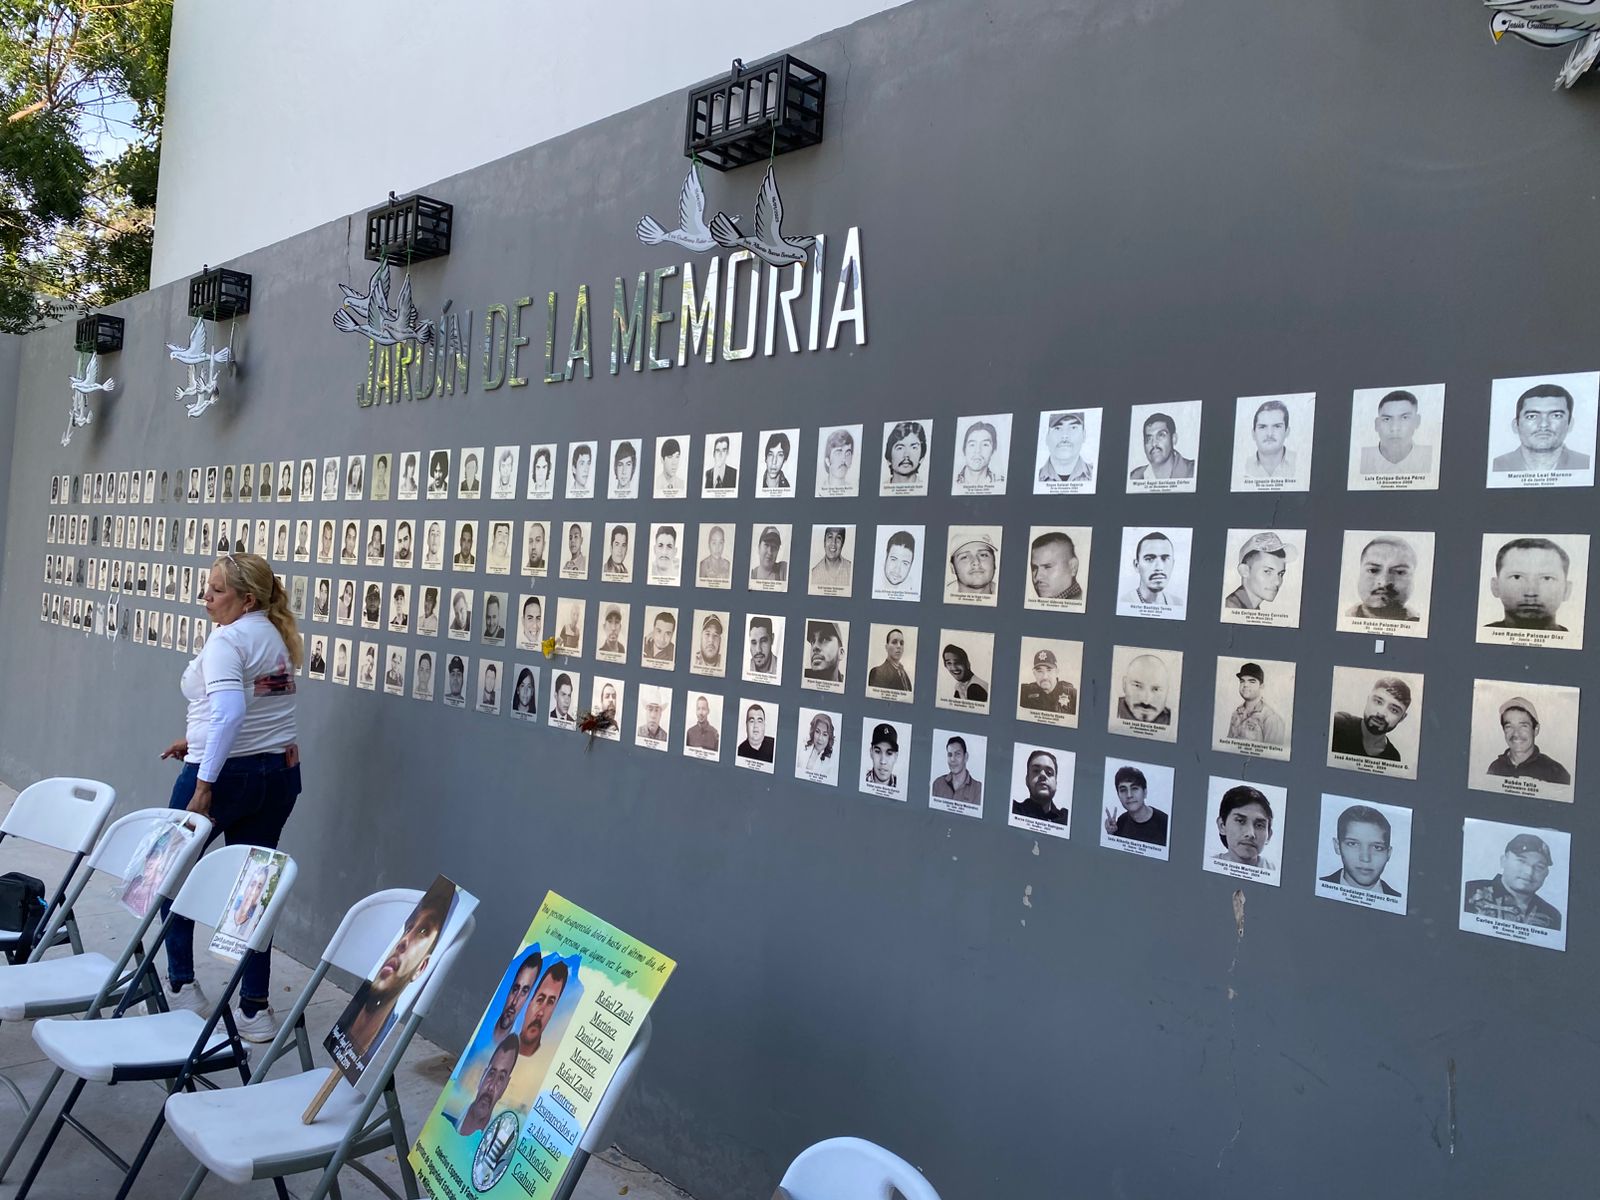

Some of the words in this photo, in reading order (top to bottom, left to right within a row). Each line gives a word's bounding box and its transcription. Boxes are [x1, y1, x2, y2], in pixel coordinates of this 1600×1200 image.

[356, 299, 473, 409] JARDÍN
[482, 296, 532, 391] DE
[544, 284, 592, 384] LA
[610, 226, 866, 376] MEMORIA
[605, 959, 616, 968] vez
[606, 936, 620, 950] hasta
[621, 944, 630, 954] el
[657, 962, 666, 974] de
[596, 990, 616, 1011] Rafael
[614, 1002, 634, 1024] Zavala
[590, 1011, 618, 1038] Martínez
[576, 1025, 597, 1048] Daniel
[594, 1038, 614, 1062] Zavala
[570, 1047, 597, 1076] Martínez
[557, 1062, 577, 1084] Rafael
[574, 1075, 593, 1100] Zavala
[552, 1084, 577, 1115] Contreras
[534, 1096, 570, 1138] Desaparecidos
[569, 1131, 579, 1144] el
[518, 1136, 528, 1154] En
[528, 1145, 553, 1180] Monclova
[534, 1126, 551, 1146] Abril
[548, 1142, 562, 1158] 2010
[514, 1162, 536, 1195] Coahuila
